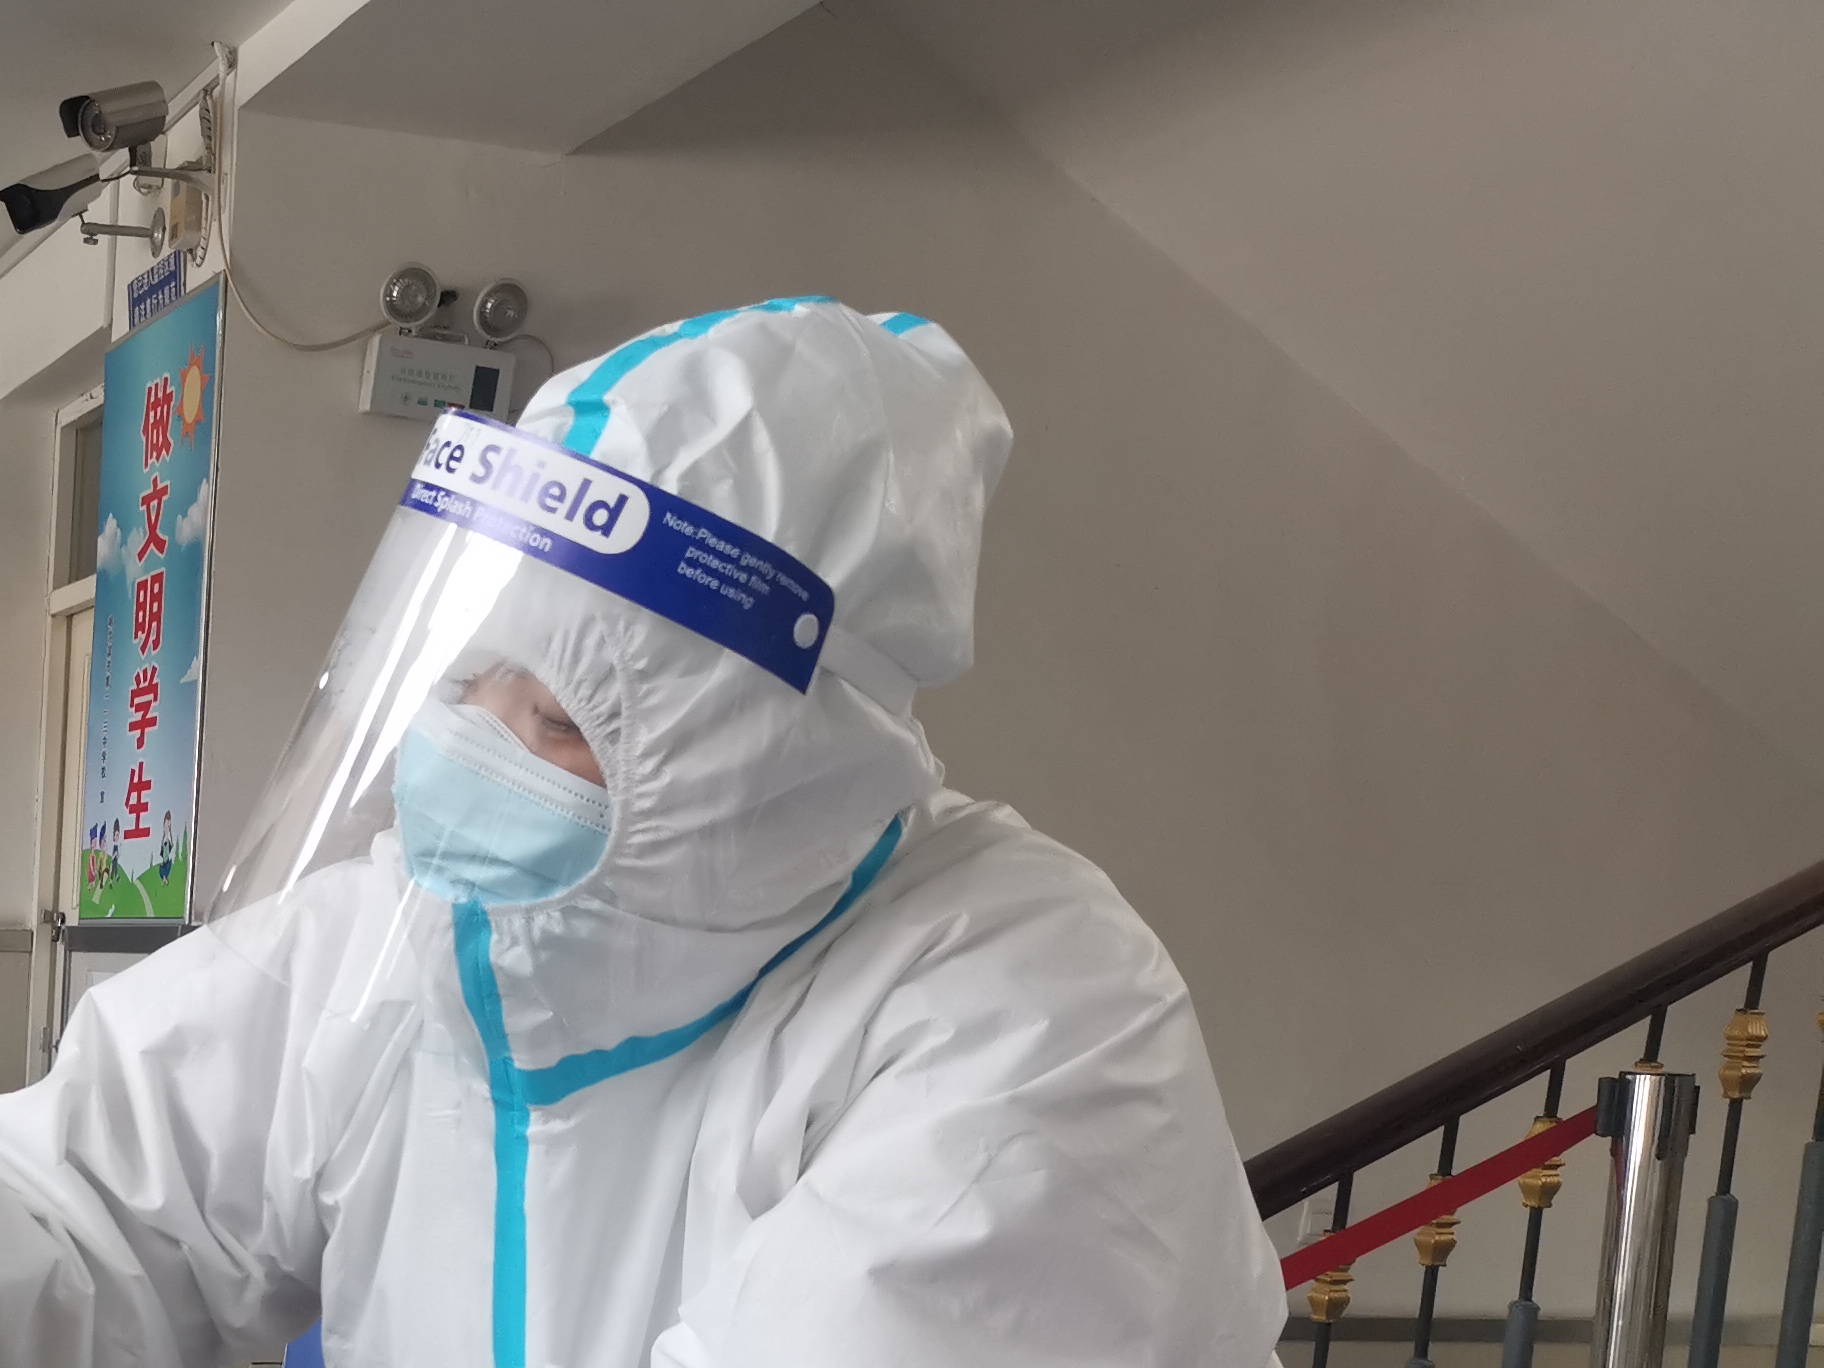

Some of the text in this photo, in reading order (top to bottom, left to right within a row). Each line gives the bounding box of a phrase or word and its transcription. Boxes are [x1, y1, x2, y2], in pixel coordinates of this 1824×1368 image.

[468, 443, 629, 539] Shield
[677, 559, 756, 611] before using
[684, 545, 749, 584] protective
[123, 377, 175, 842] 做文明学生
